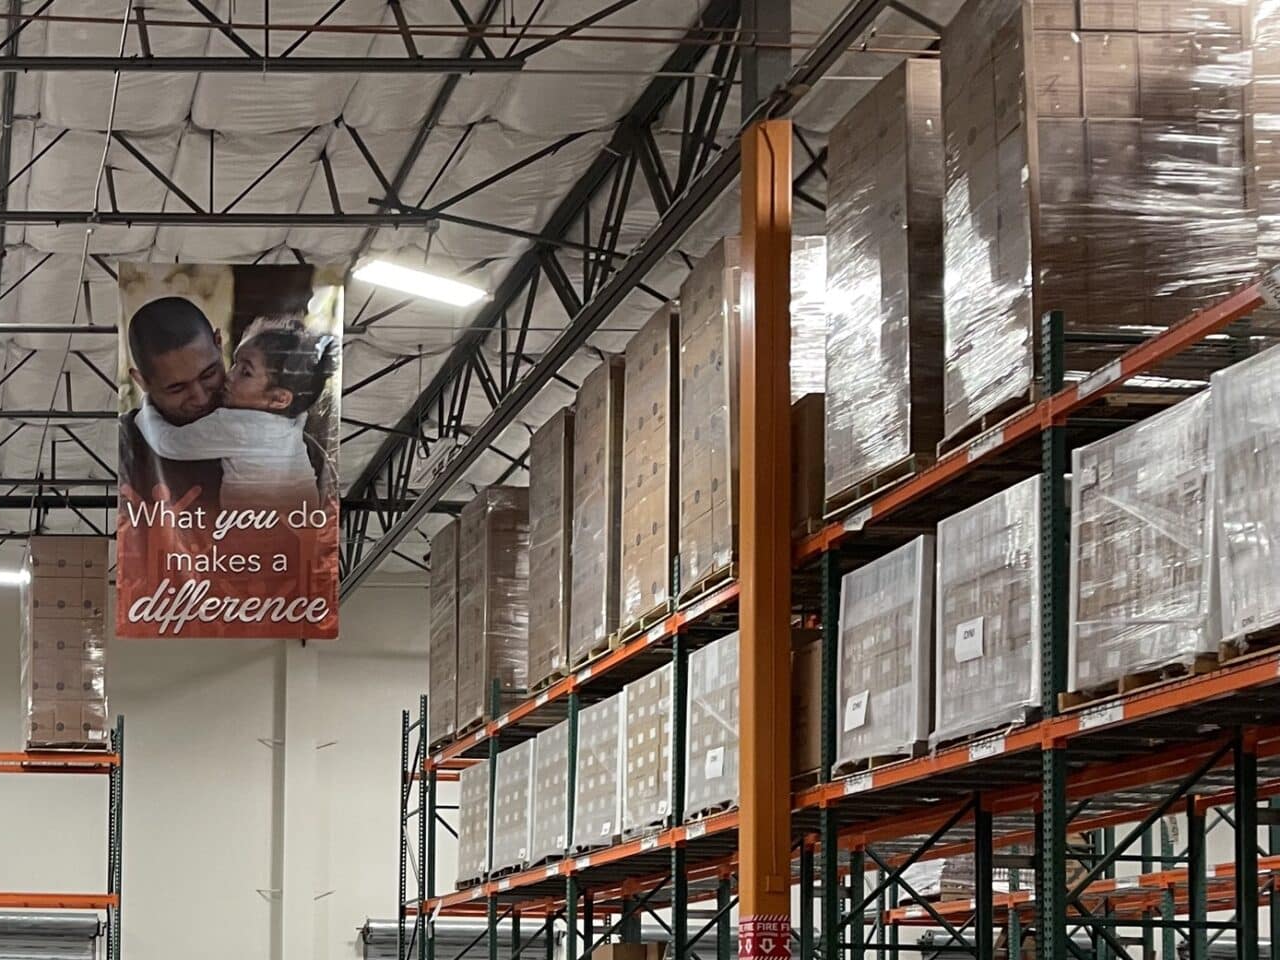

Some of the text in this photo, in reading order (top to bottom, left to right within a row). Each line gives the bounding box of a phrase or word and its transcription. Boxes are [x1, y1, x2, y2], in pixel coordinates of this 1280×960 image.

[127, 500, 327, 540] What you do
[166, 545, 287, 572] makes a
[128, 578, 329, 635] difference
[756, 922, 778, 931] FIRE
